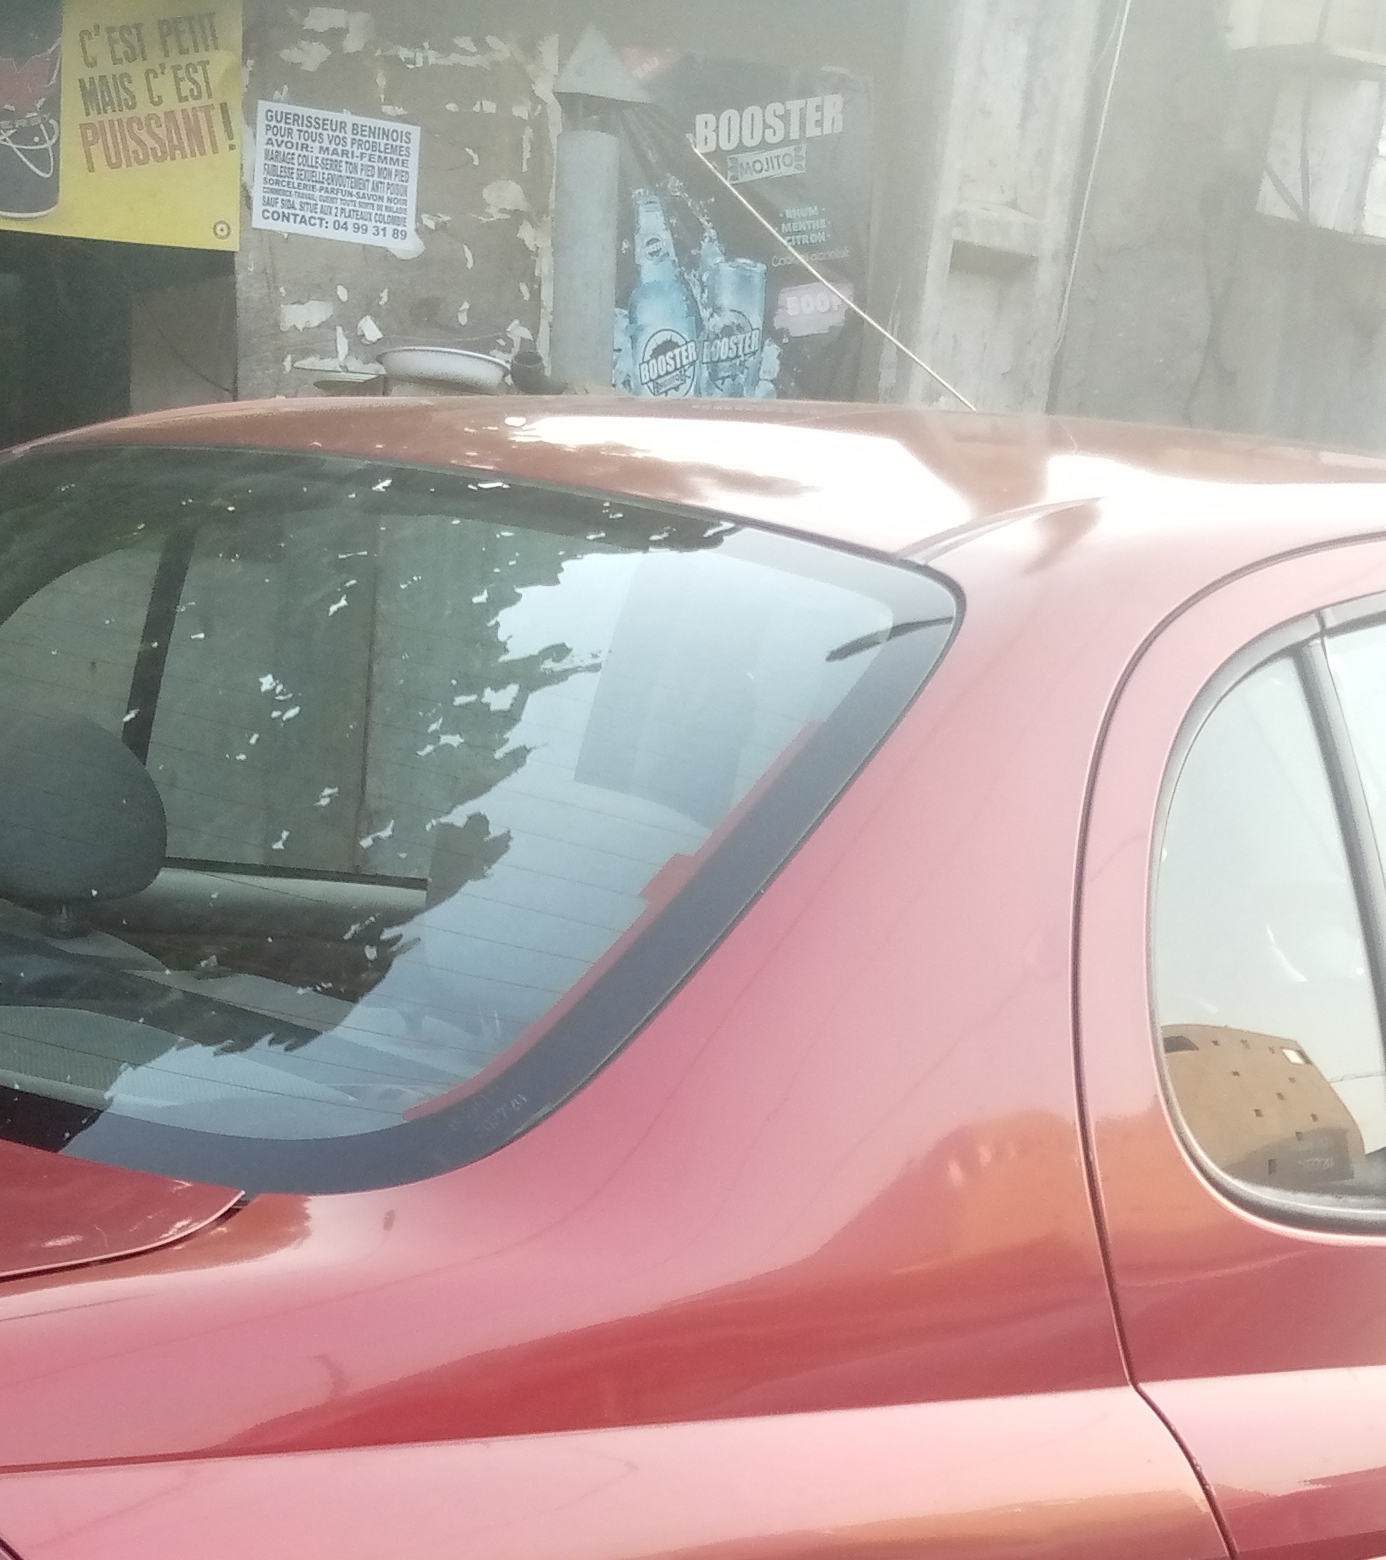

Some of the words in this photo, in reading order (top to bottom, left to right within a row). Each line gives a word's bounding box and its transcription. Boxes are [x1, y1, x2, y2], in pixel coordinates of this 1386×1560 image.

[78, 22, 148, 69] C'EST
[157, 11, 220, 58] PETIT
[78, 72, 136, 117] MAIS
[144, 60, 214, 107] C'EST
[79, 101, 237, 173] PUISSANT!
[265, 109, 347, 135] GUERISSEUR
[351, 123, 412, 145] BENINOIS
[694, 93, 845, 154] BOOSTER
[265, 124, 294, 140] POUR
[297, 128, 324, 145] TOUS
[327, 133, 348, 148] VOS
[351, 137, 411, 158] PROBLEMES
[265, 138, 314, 153] AVOIR:
[319, 145, 409, 168] MARI-FEMME
[264, 148, 296, 165] MARIAGE
[345, 161, 358, 175] TON
[739, 153, 794, 176] MOJITO
[334, 206, 339, 218] 2
[387, 195, 408, 207] NOIR
[261, 209, 329, 229] CONTACT:
[333, 219, 349, 232] 04
[352, 222, 369, 235] 99
[372, 226, 387, 238] 31
[392, 229, 408, 241] 89
[639, 341, 697, 385] BOOSTER
